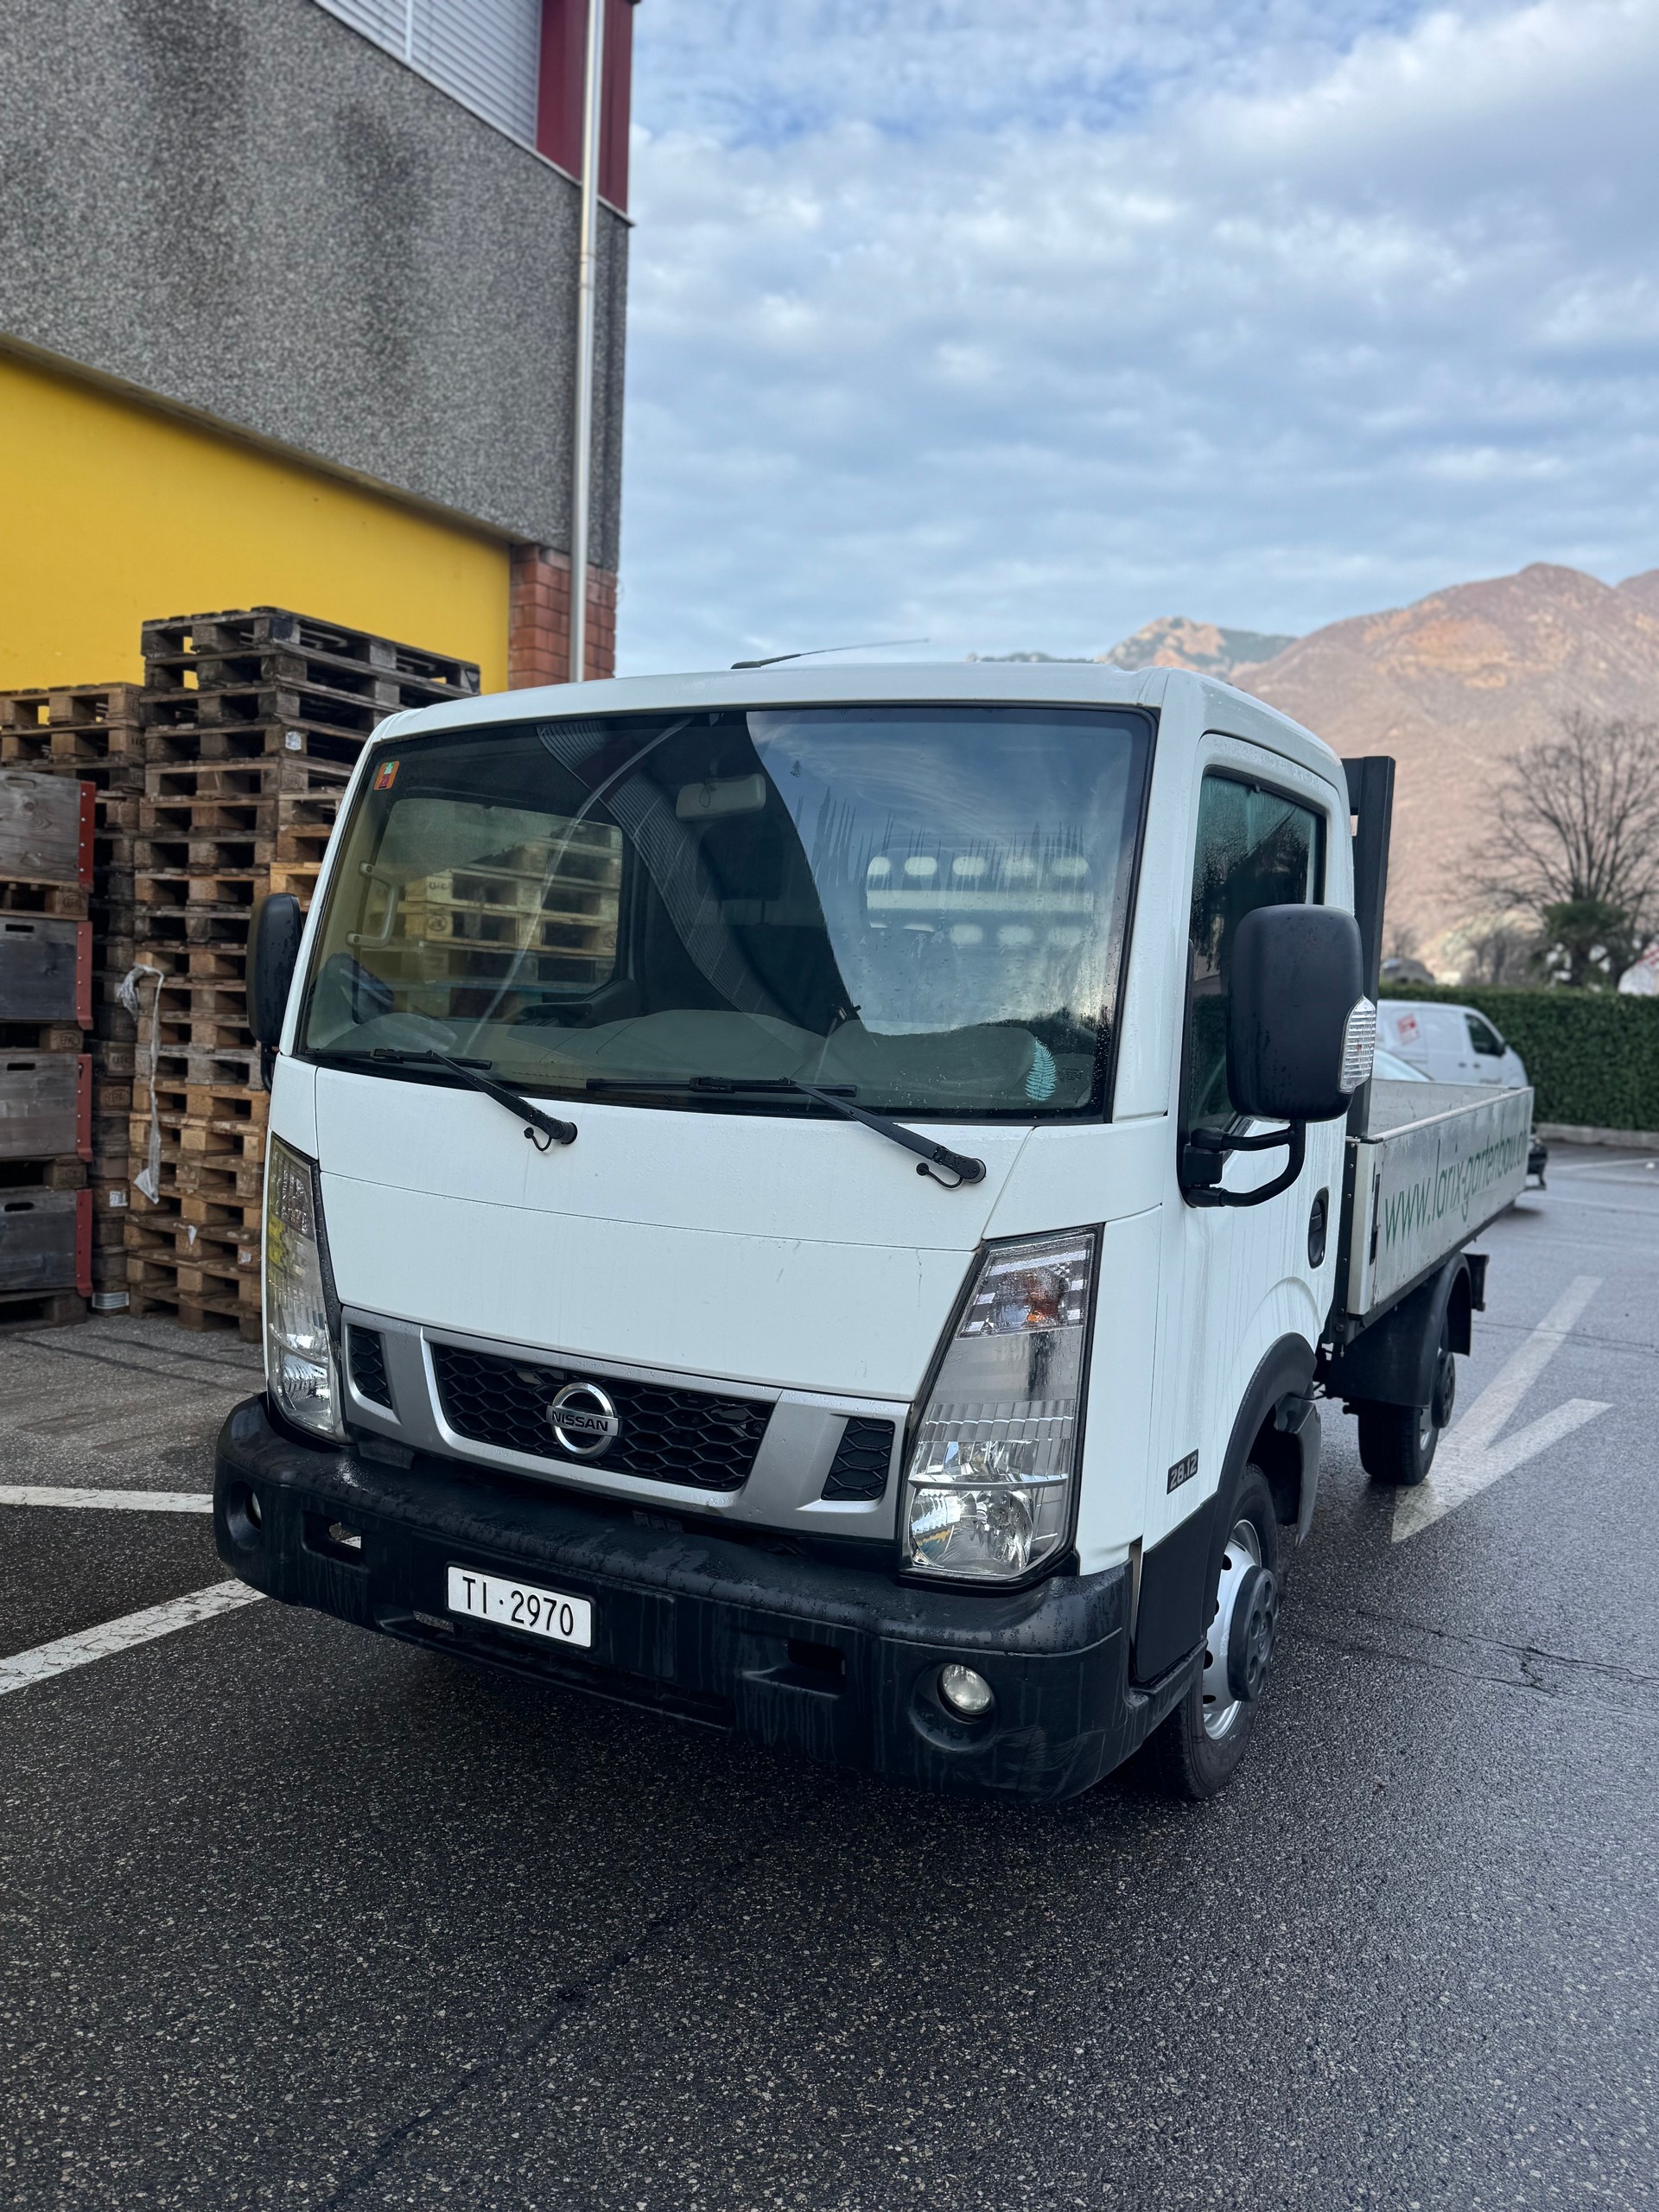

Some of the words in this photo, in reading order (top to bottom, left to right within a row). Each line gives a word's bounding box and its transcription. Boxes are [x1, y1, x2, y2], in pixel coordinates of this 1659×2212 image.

[1384, 1103, 1529, 1251] www.larix-gartenbau.ch
[551, 1410, 608, 1432] NISSAN
[1169, 1453, 1198, 1491] 28.12
